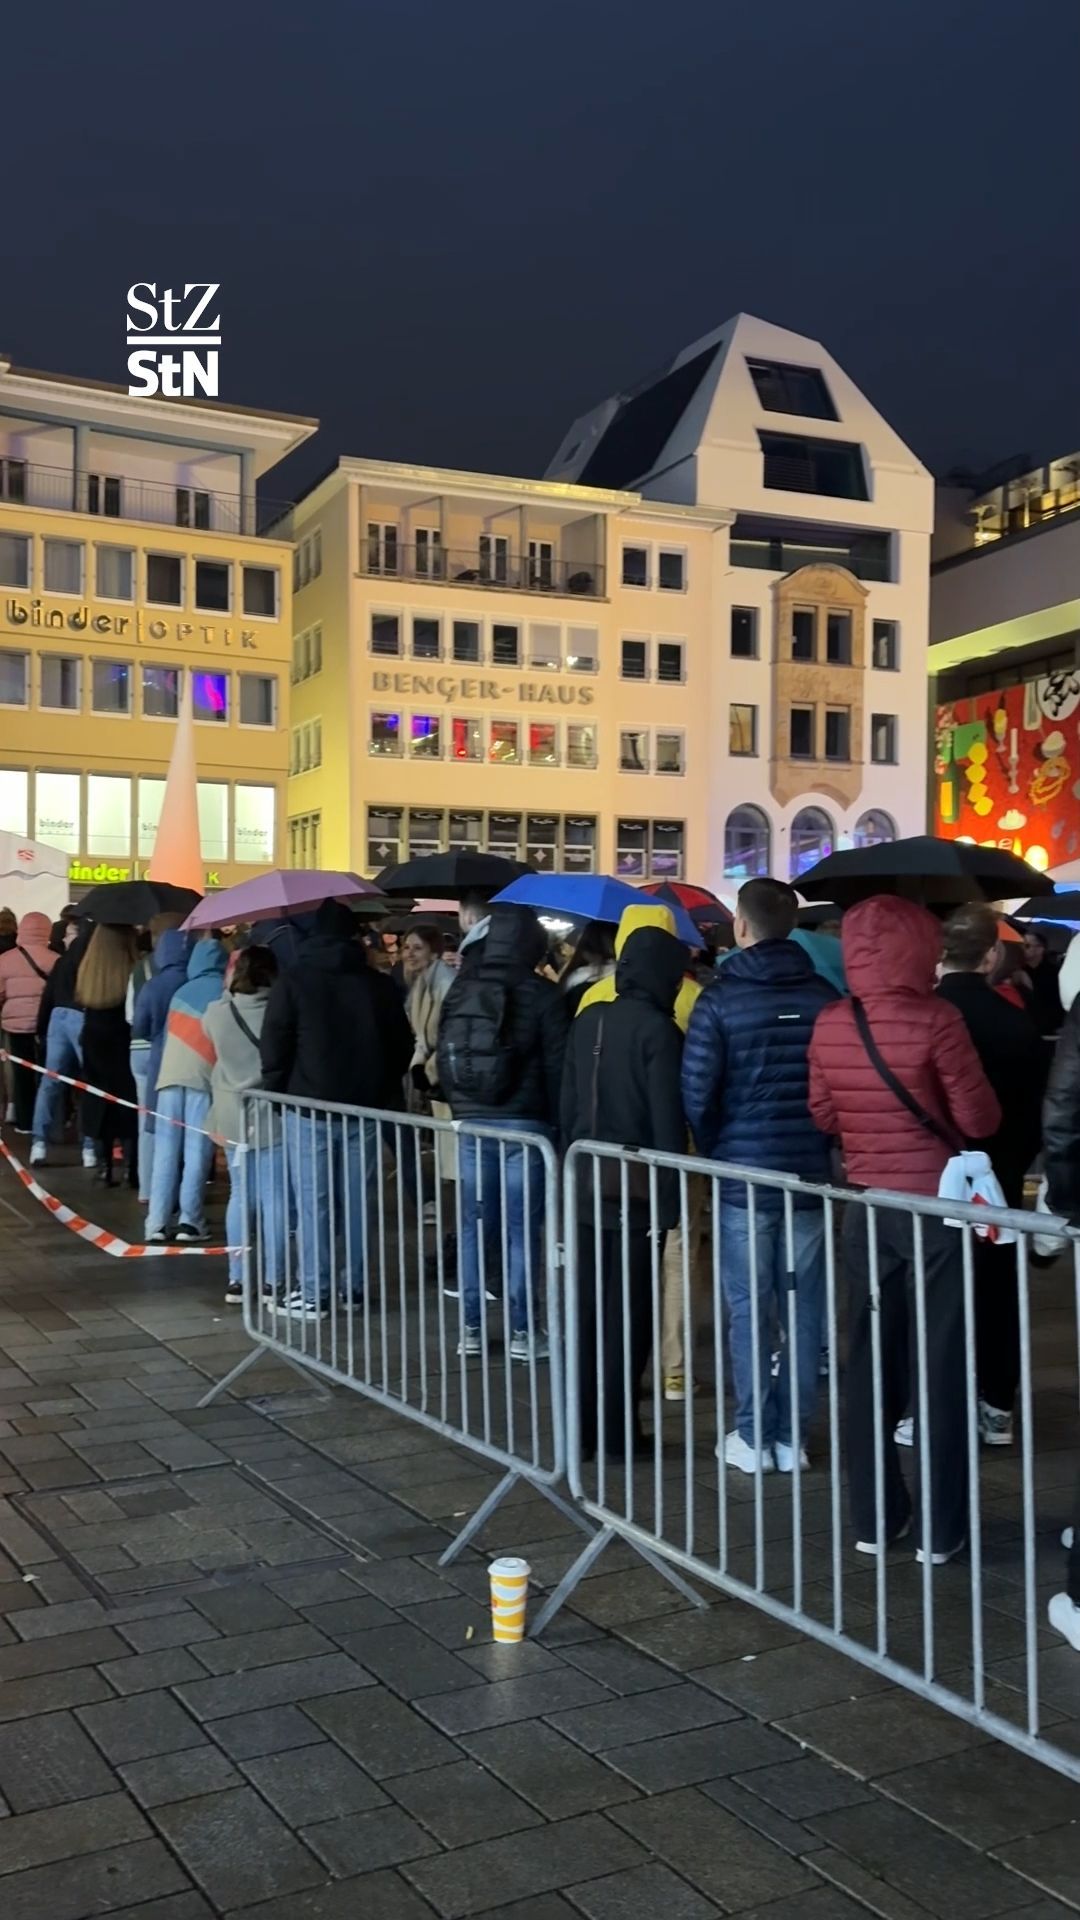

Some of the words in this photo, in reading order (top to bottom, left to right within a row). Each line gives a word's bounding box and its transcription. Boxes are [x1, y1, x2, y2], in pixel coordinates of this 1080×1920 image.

[7, 600, 131, 634] binder
[150, 619, 259, 649] OPTIK
[371, 671, 595, 705] BENGER-HAUS
[68, 860, 130, 881] inder
